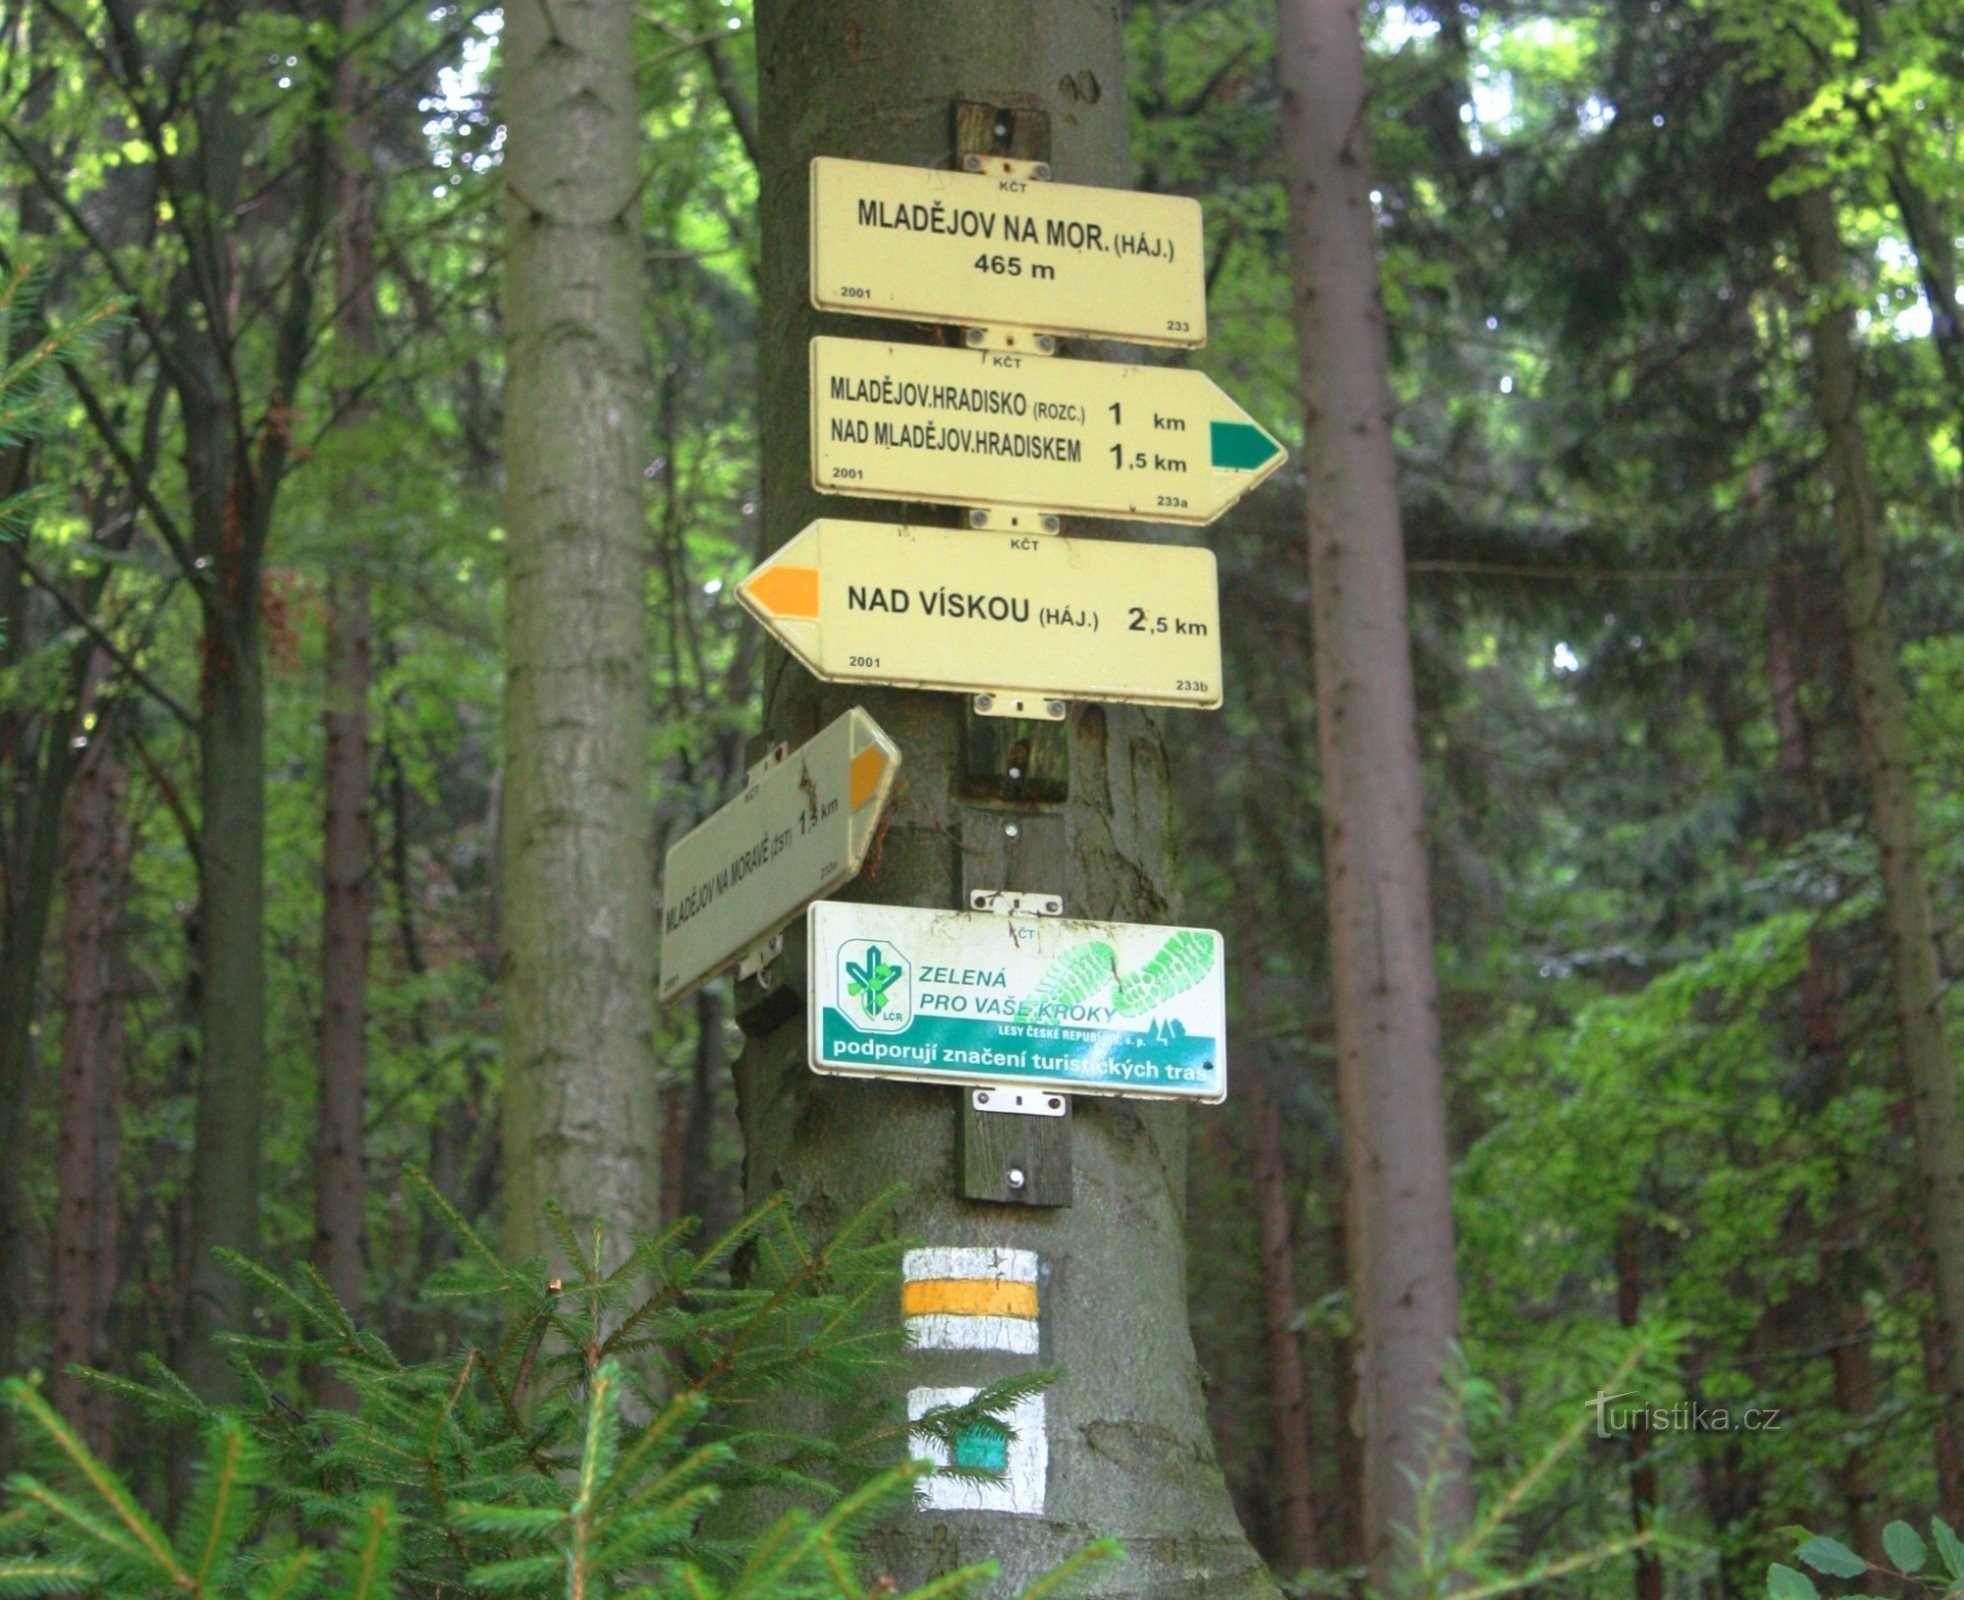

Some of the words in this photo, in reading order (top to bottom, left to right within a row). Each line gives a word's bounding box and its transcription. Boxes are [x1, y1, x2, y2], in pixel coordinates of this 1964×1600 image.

[1000, 180, 1027, 193] KČT
[858, 199, 996, 239] MLADĚJOV
[1004, 215, 1038, 244] NA
[1046, 220, 1109, 251] MOR.
[1114, 232, 1175, 263] (HÁJ.)
[974, 253, 1021, 276] 465
[1031, 263, 1055, 280] m
[840, 286, 871, 298] 2001
[1166, 320, 1190, 332] 233
[993, 355, 1021, 369] KČT
[830, 375, 1027, 416] MLADĚJOV.HRADISKO
[1033, 401, 1085, 426] (ROZC.)
[1108, 402, 1122, 425] 1
[1154, 413, 1186, 432] km
[831, 418, 869, 445] NAD
[874, 420, 1081, 463] MLADĚJOV.HRADISKEM
[1110, 444, 1147, 472] 1,5
[1154, 455, 1187, 472] km
[833, 467, 863, 480] 2001
[1157, 496, 1188, 509] 233a
[1011, 537, 1039, 552] KČT
[847, 585, 910, 613] NAD
[919, 587, 1030, 623] VÍSKOU
[1039, 606, 1099, 632] (HÁJ.)
[1128, 607, 1168, 635] 2,5
[1176, 618, 1207, 637] km
[849, 656, 881, 668] 2001
[1176, 680, 1208, 693] 233b
[716, 868, 728, 896] NA
[821, 798, 838, 820] km
[918, 966, 1007, 988] ZELENÁ
[919, 994, 966, 1012] PRO
[975, 995, 1031, 1018] VAŠE
[1038, 1002, 1116, 1023] KROKY
[998, 1025, 1024, 1037] LESY
[1026, 1025, 1060, 1040] ČESKÉ
[833, 1038, 938, 1062] podporují
[943, 1046, 1026, 1069] značení
[1031, 1053, 1158, 1083] turistických
[1165, 1063, 1208, 1083] tras
